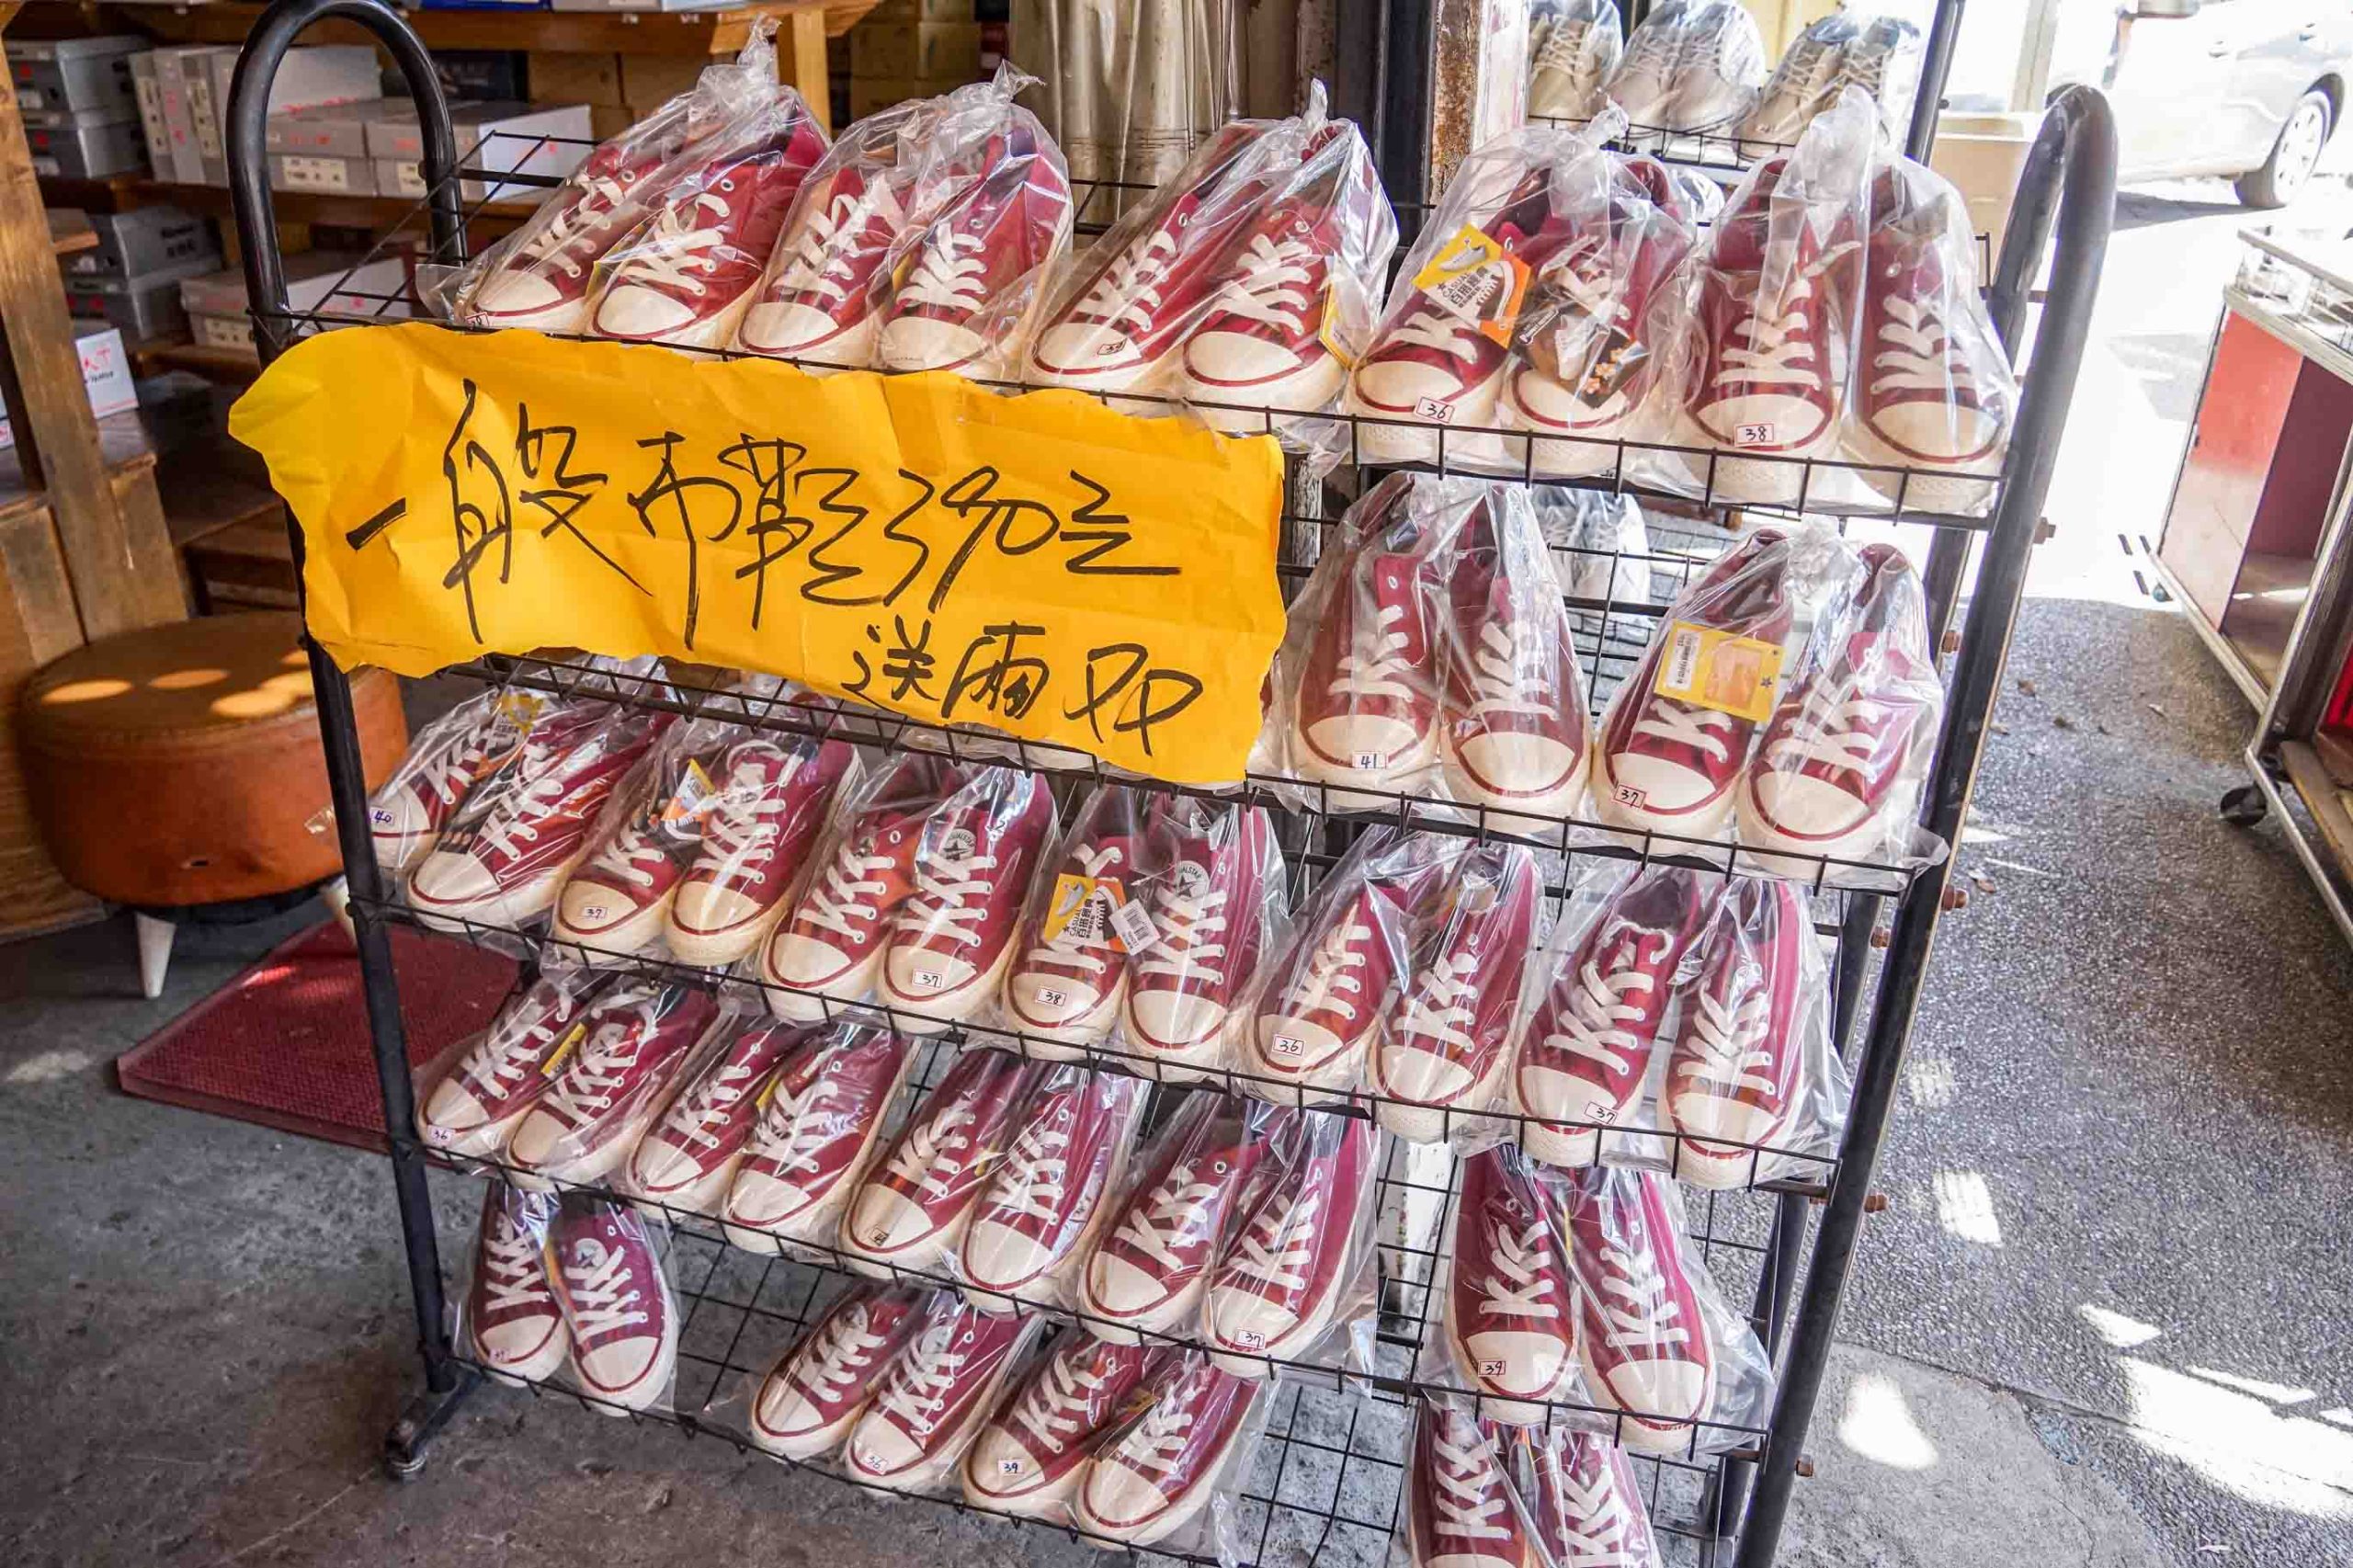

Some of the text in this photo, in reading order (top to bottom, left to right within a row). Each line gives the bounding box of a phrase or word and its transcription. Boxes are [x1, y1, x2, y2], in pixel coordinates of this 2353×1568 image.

[1427, 404, 1447, 419] 36
[1745, 426, 1767, 441] 38
[1360, 753, 1378, 769] 41
[1620, 790, 1639, 808] 37
[371, 810, 392, 824] 40
[586, 908, 603, 920] 37
[921, 973, 938, 988] 37
[1045, 991, 1062, 1005] 38
[1278, 1038, 1299, 1052] 36
[1596, 1107, 1616, 1124] 37
[1245, 1332, 1261, 1350] 37
[1485, 1361, 1503, 1376] 39
[1003, 1462, 1018, 1474] 39
